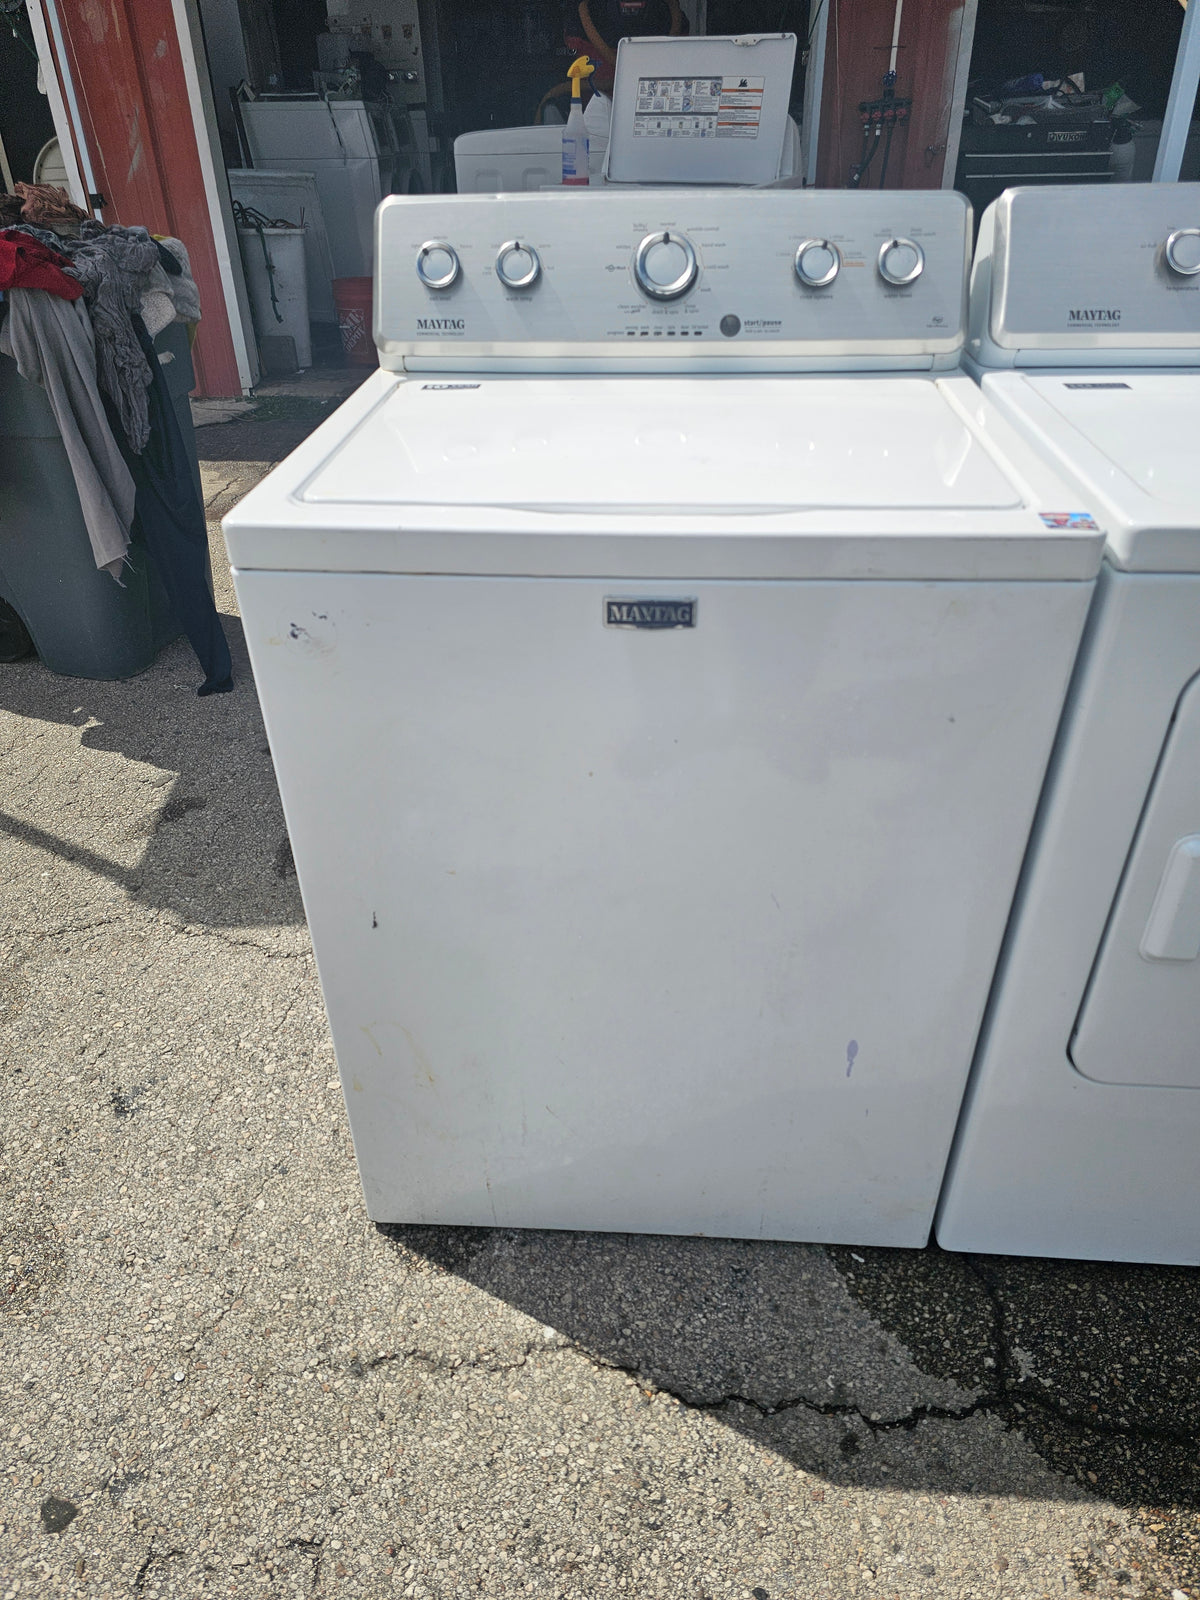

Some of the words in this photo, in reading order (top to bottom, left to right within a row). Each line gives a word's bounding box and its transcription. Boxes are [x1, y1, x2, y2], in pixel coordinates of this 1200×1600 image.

[1068, 309, 1121, 321] MAYTAG
[416, 319, 465, 330] MAYTAG
[743, 319, 782, 327] start/pause
[609, 604, 690, 622] MAYTAG
